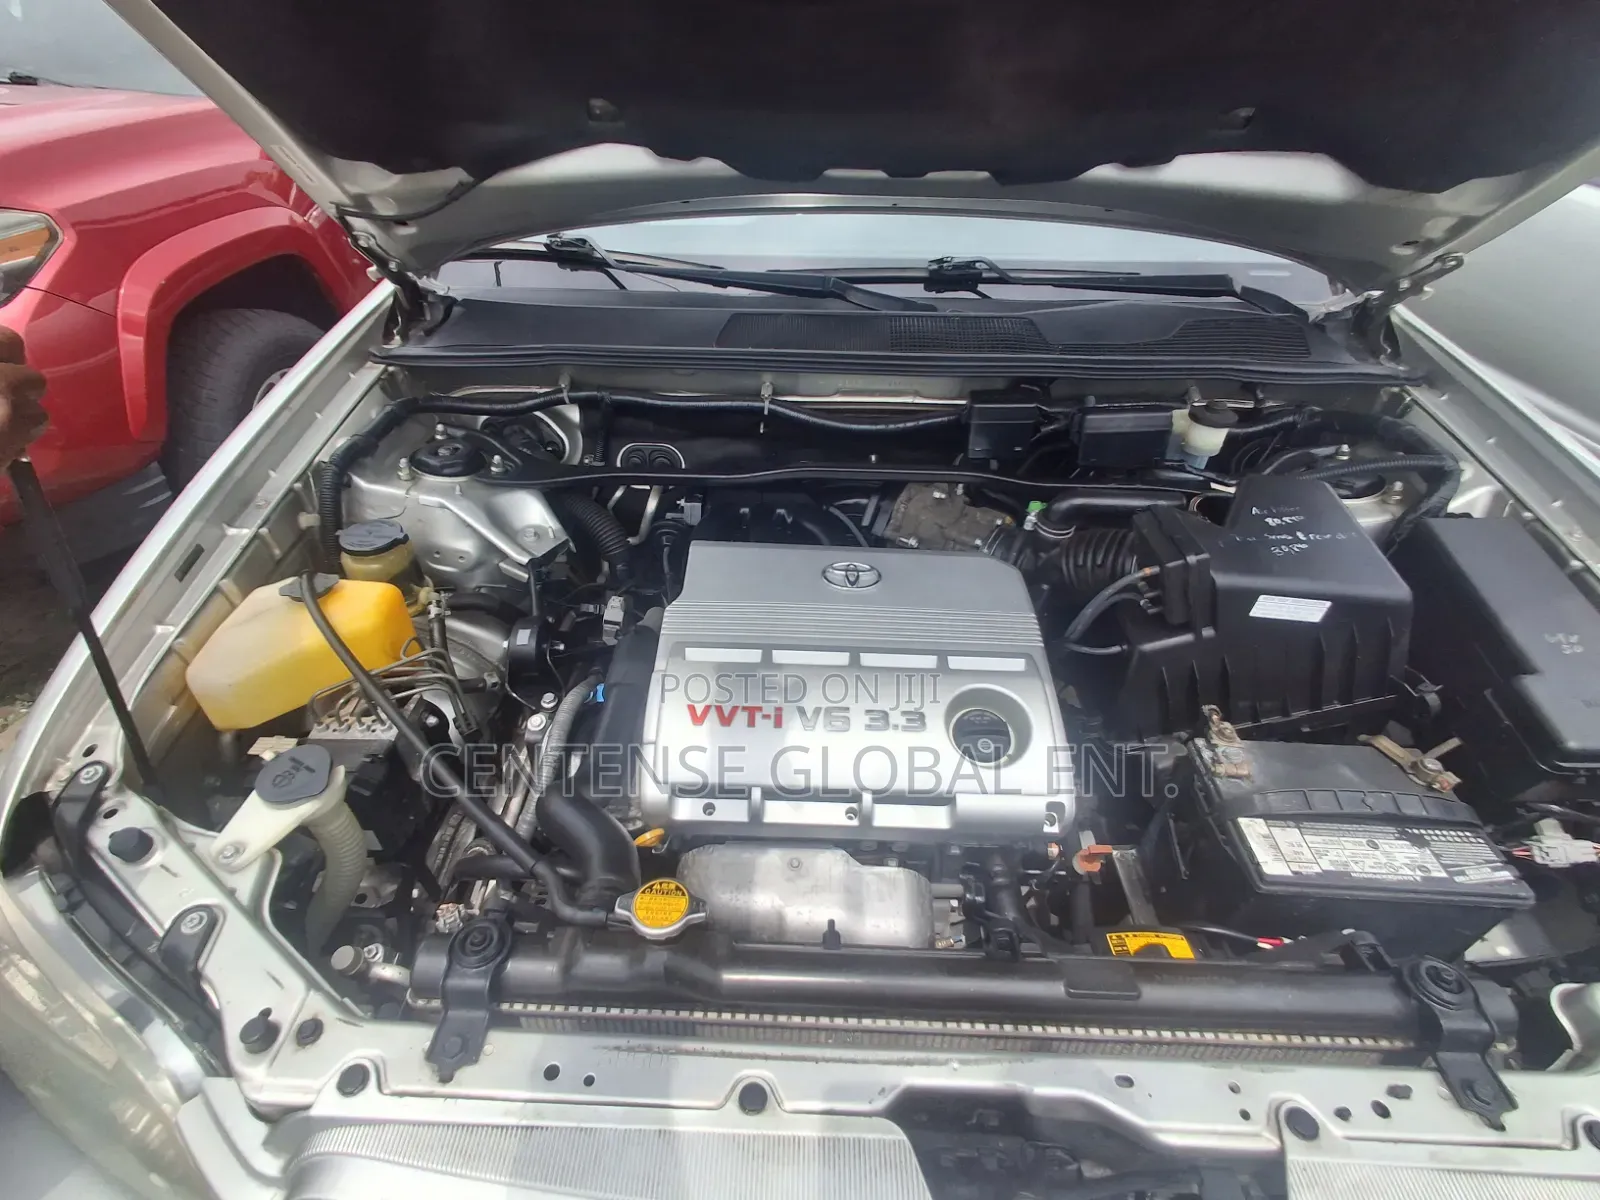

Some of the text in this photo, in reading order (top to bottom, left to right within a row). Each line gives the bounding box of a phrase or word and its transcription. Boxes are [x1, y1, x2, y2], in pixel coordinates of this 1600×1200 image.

[687, 704, 927, 732] VVT-i V6 3.3
[645, 888, 683, 896] CAUTION
